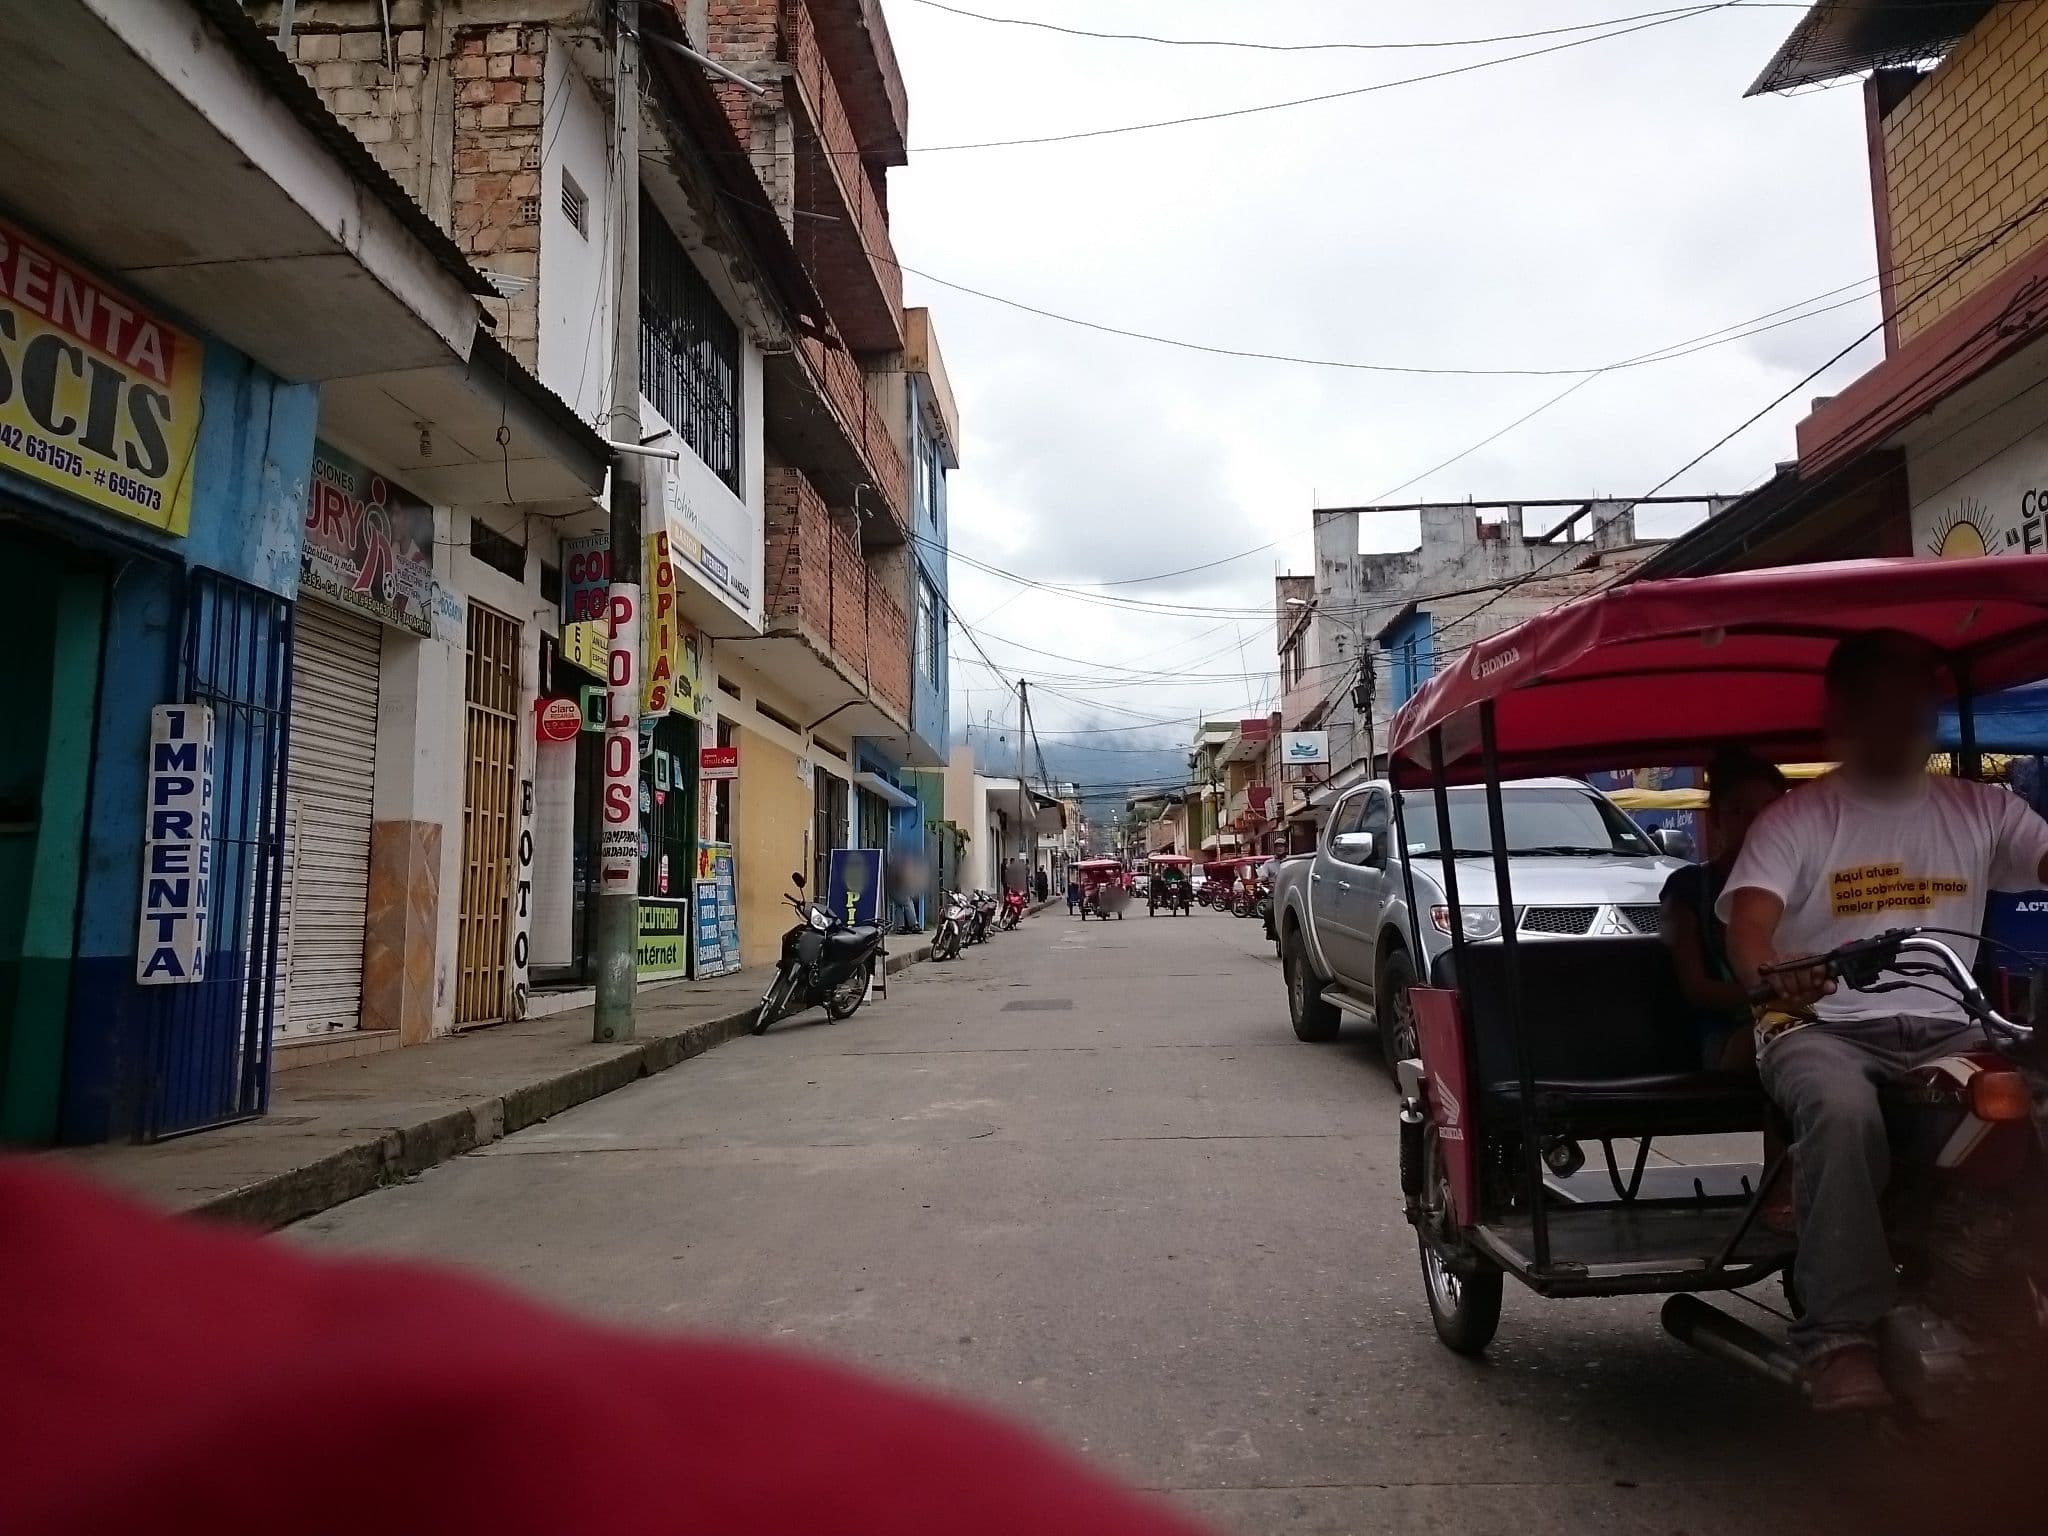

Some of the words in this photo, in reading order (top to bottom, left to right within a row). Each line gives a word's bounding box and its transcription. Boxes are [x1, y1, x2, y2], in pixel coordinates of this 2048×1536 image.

[0, 308, 171, 479] CIS
[0, 423, 21, 452] 42
[26, 434, 82, 477] 631575
[94, 468, 106, 487] #
[109, 473, 162, 511] 695673
[574, 587, 609, 620] FO
[650, 531, 673, 711] COPIAS
[1481, 647, 1520, 677] HONDA
[550, 704, 575, 713] Claro
[605, 596, 632, 823] POLOS
[142, 710, 197, 978] IMPRENTA
[192, 714, 213, 977] IMPRENTA
[1836, 888, 1862, 900] solo
[1837, 900, 1873, 913] mejor
